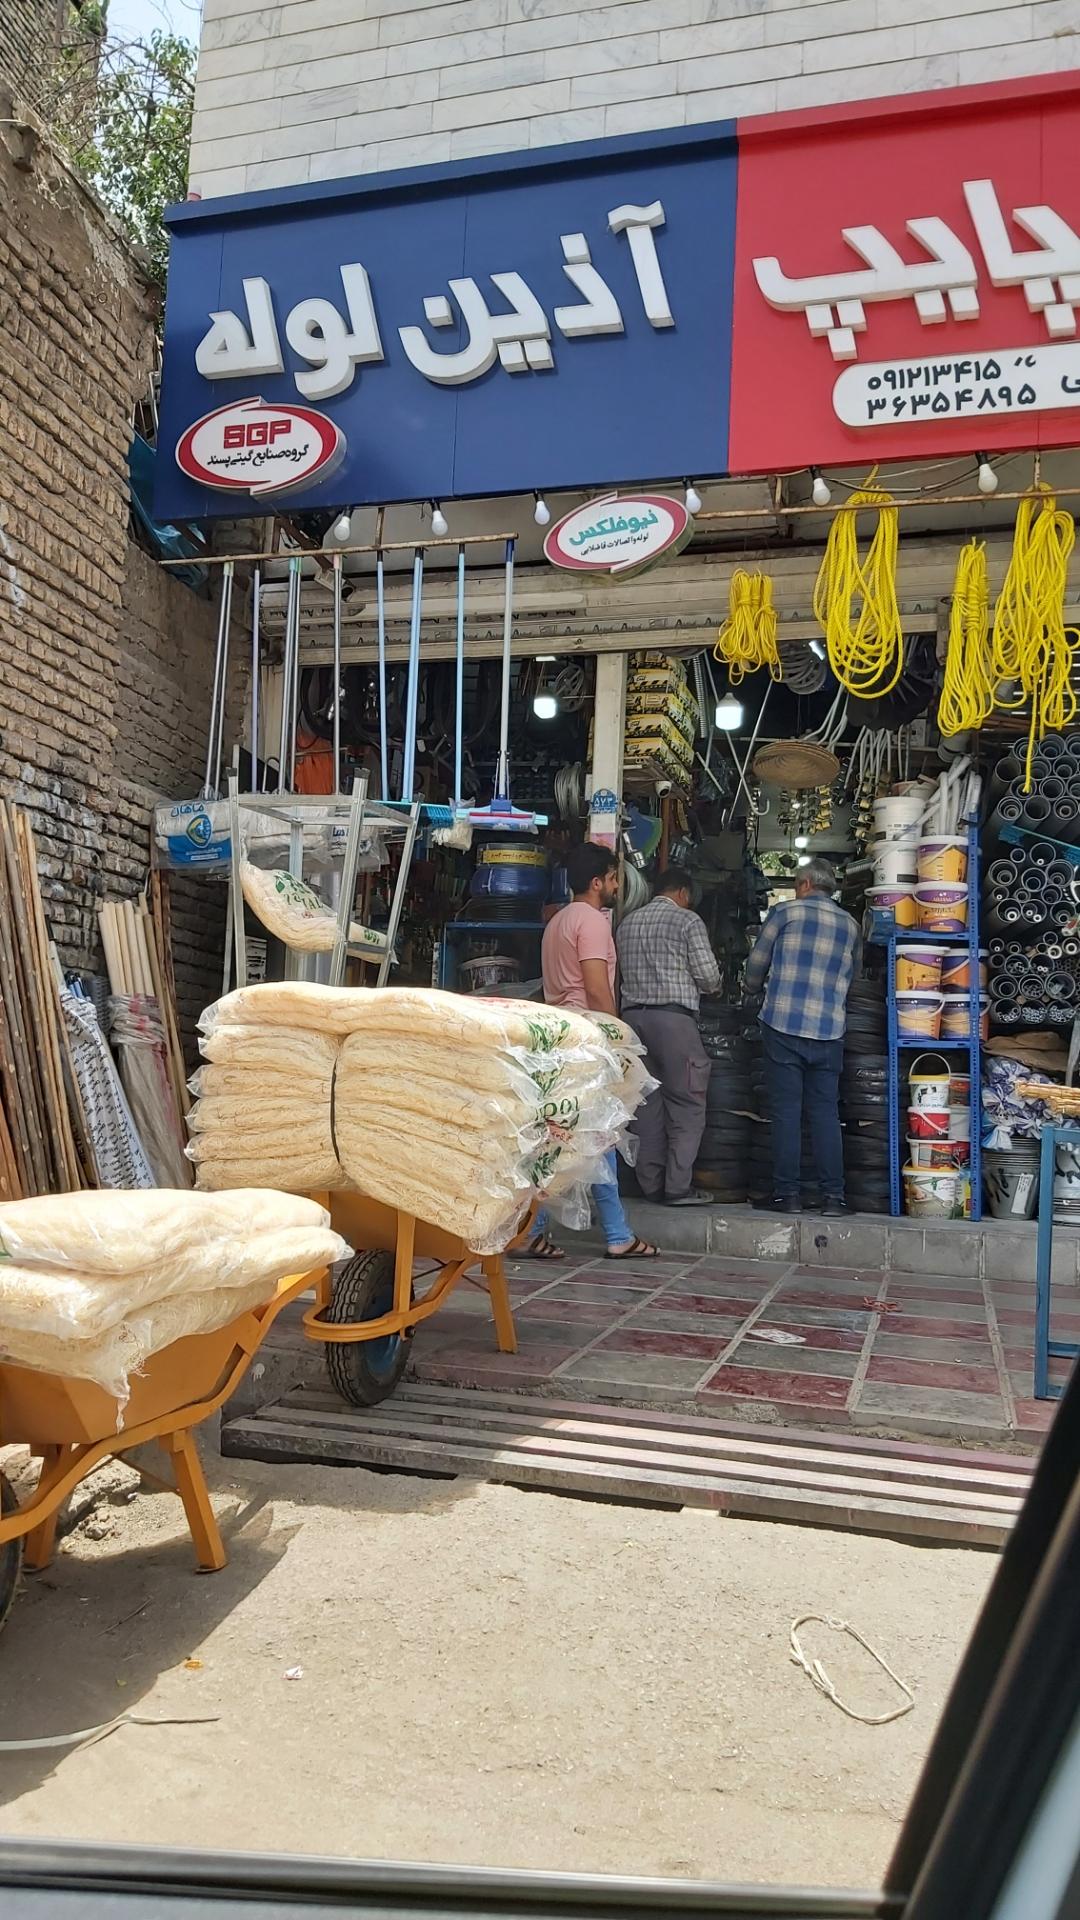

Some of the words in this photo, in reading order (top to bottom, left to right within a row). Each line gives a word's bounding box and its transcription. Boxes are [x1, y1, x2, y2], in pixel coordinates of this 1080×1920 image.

[398, 200, 675, 386] آذین
[752, 179, 1080, 361] پایپ
[195, 262, 384, 401] لوله
[224, 419, 291, 449] SGP
[866, 383, 1037, 419] ۳۶۳۵۴۸۹۵
[570, 509, 658, 545] نیوفلکس
